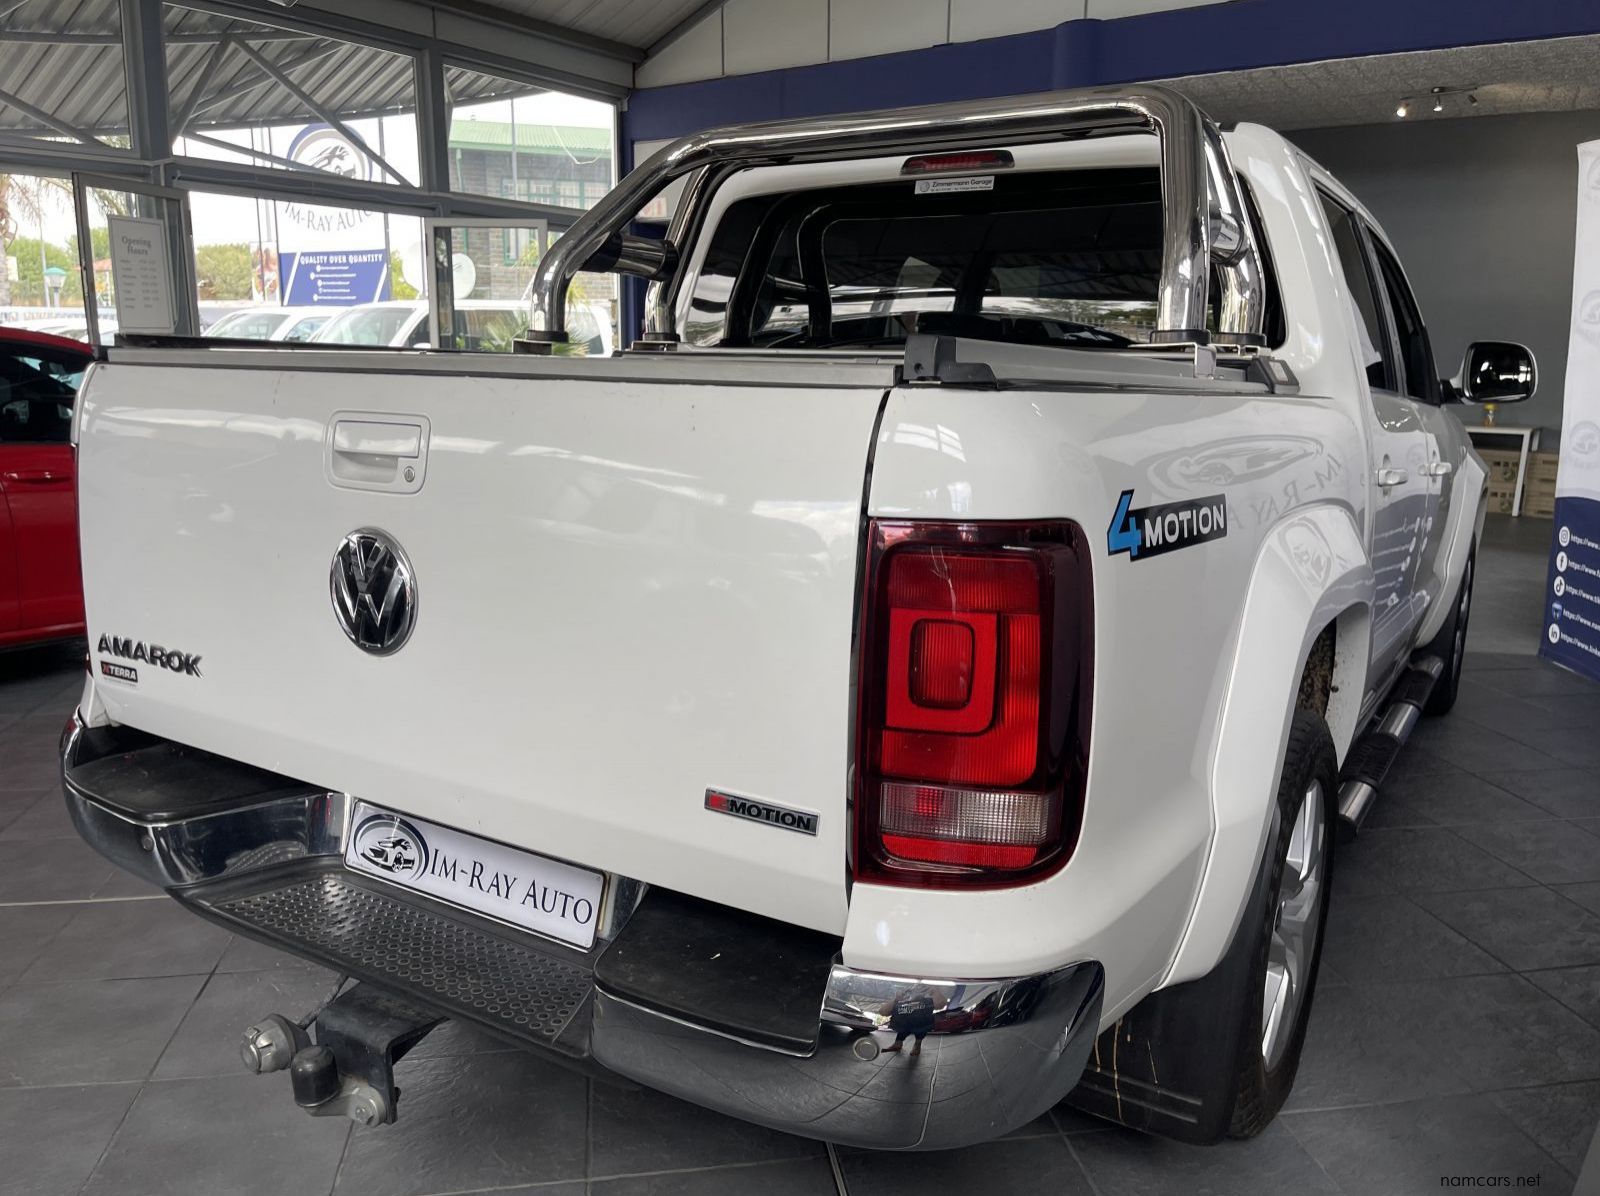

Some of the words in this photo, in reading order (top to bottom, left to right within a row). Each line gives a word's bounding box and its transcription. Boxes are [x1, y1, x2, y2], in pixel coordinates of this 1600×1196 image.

[121, 235, 152, 249] Opening
[127, 245, 148, 256] Hours
[300, 256, 328, 265] QUALITY
[329, 255, 347, 264] OVER
[349, 253, 383, 264] QUANTITY
[1107, 489, 1227, 561] 4MOTION
[97, 632, 204, 679] AMAROK
[430, 848, 518, 900] IM-RAY
[520, 879, 593, 925] AUTO
